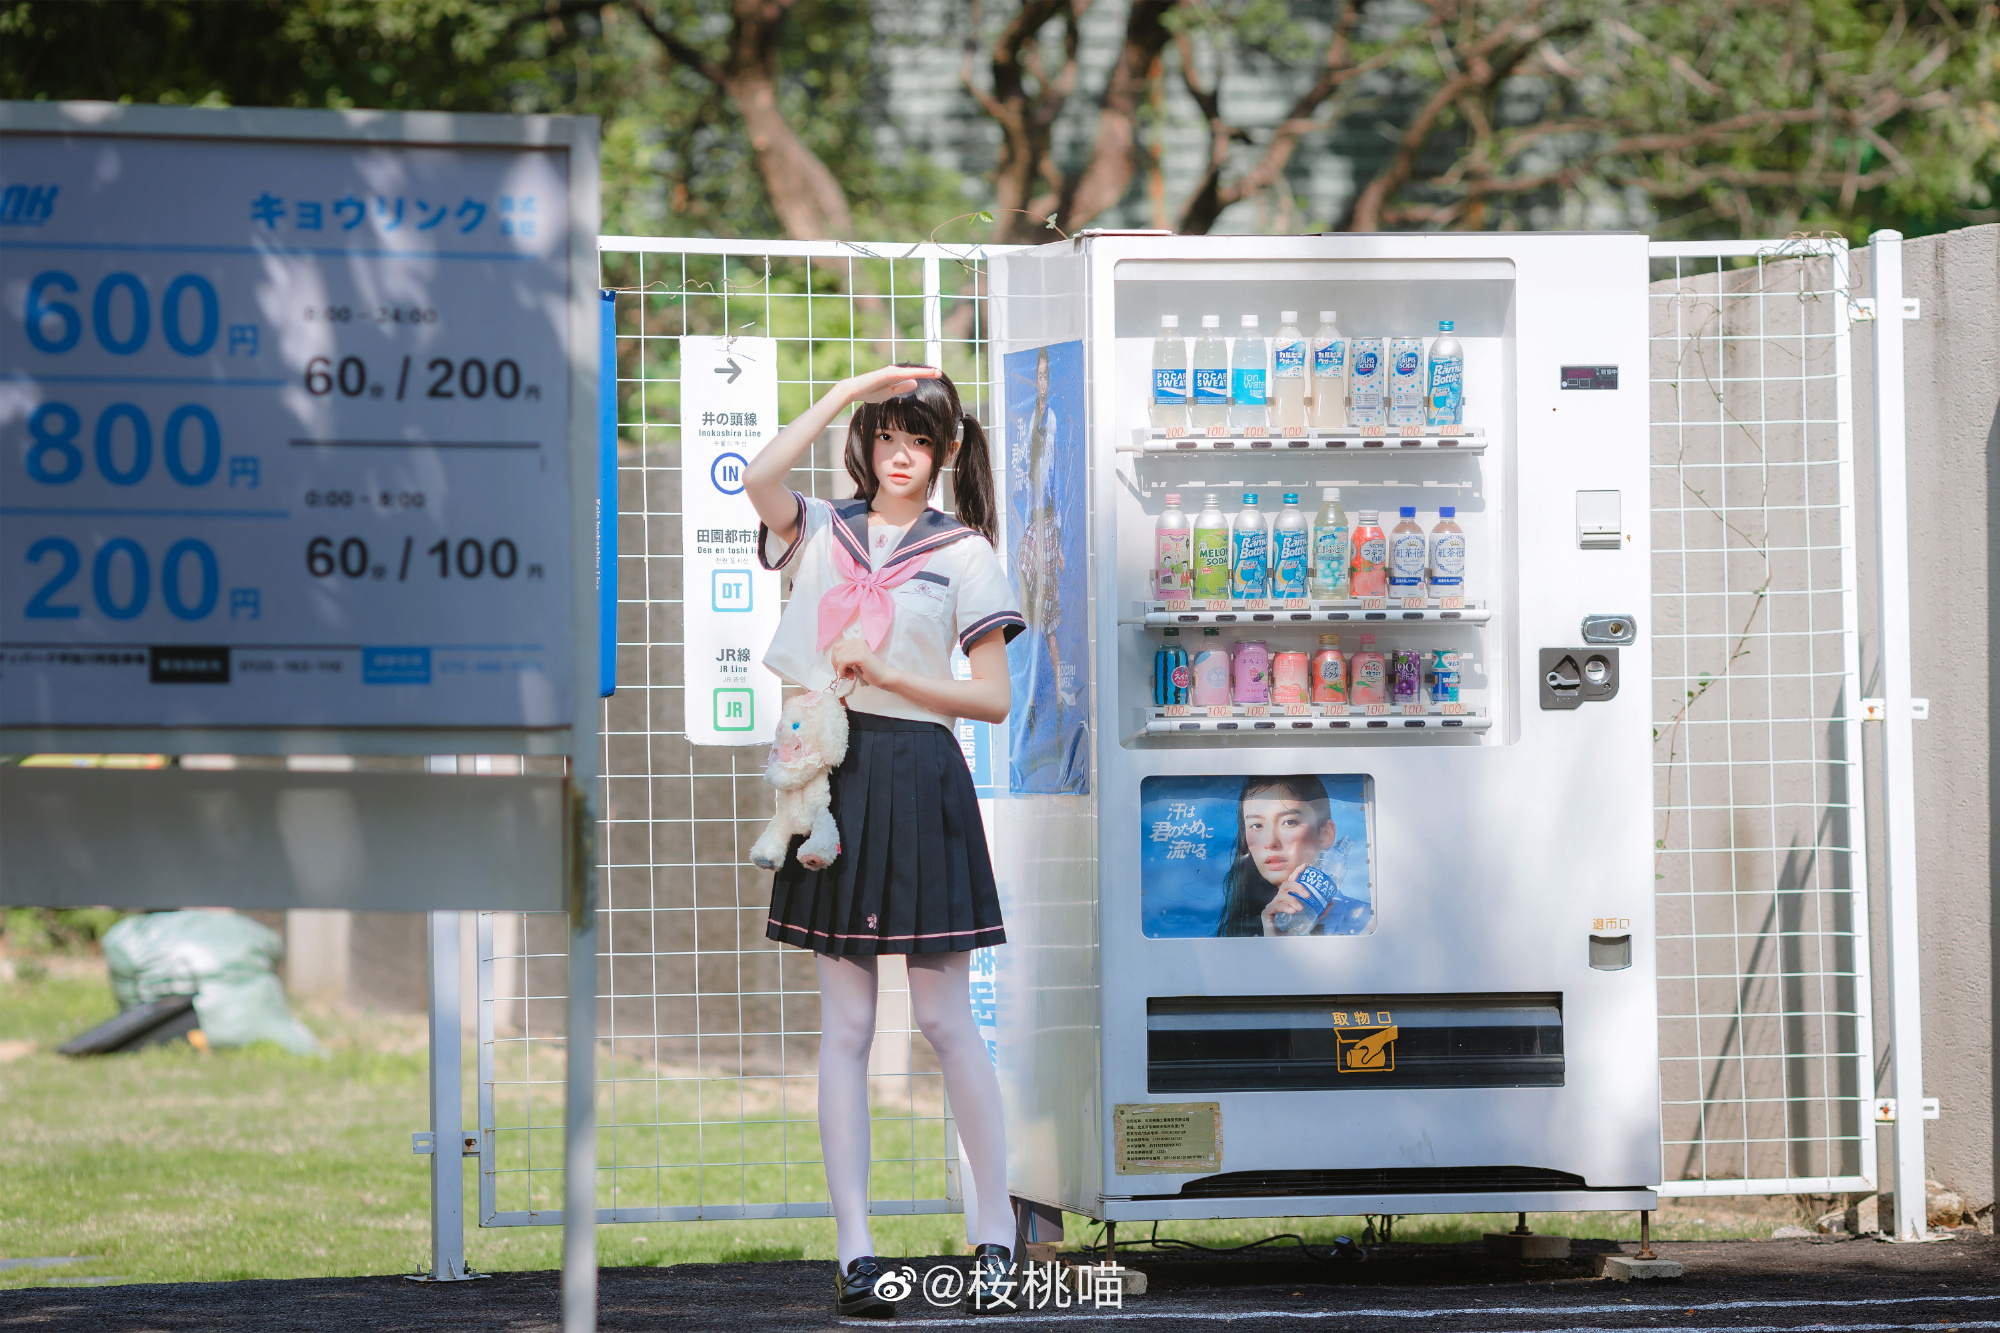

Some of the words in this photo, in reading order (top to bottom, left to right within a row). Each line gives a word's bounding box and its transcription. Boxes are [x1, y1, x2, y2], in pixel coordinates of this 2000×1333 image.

[251, 191, 487, 234] キョウリンク
[1244, 372, 1258, 381] ion
[1432, 373, 1459, 386] Bottle
[702, 412, 758, 426] 井の頭線
[698, 429, 742, 437] Inokashira
[744, 429, 762, 438] Line
[722, 466, 738, 482] IN
[722, 583, 742, 599] DT
[716, 648, 751, 662] JR線
[725, 702, 742, 718] JR
[1167, 803, 1195, 820] 汗は
[1149, 819, 1214, 842] 君のために
[1592, 917, 1630, 930] 退币口
[1332, 1011, 1392, 1025] 取物口
